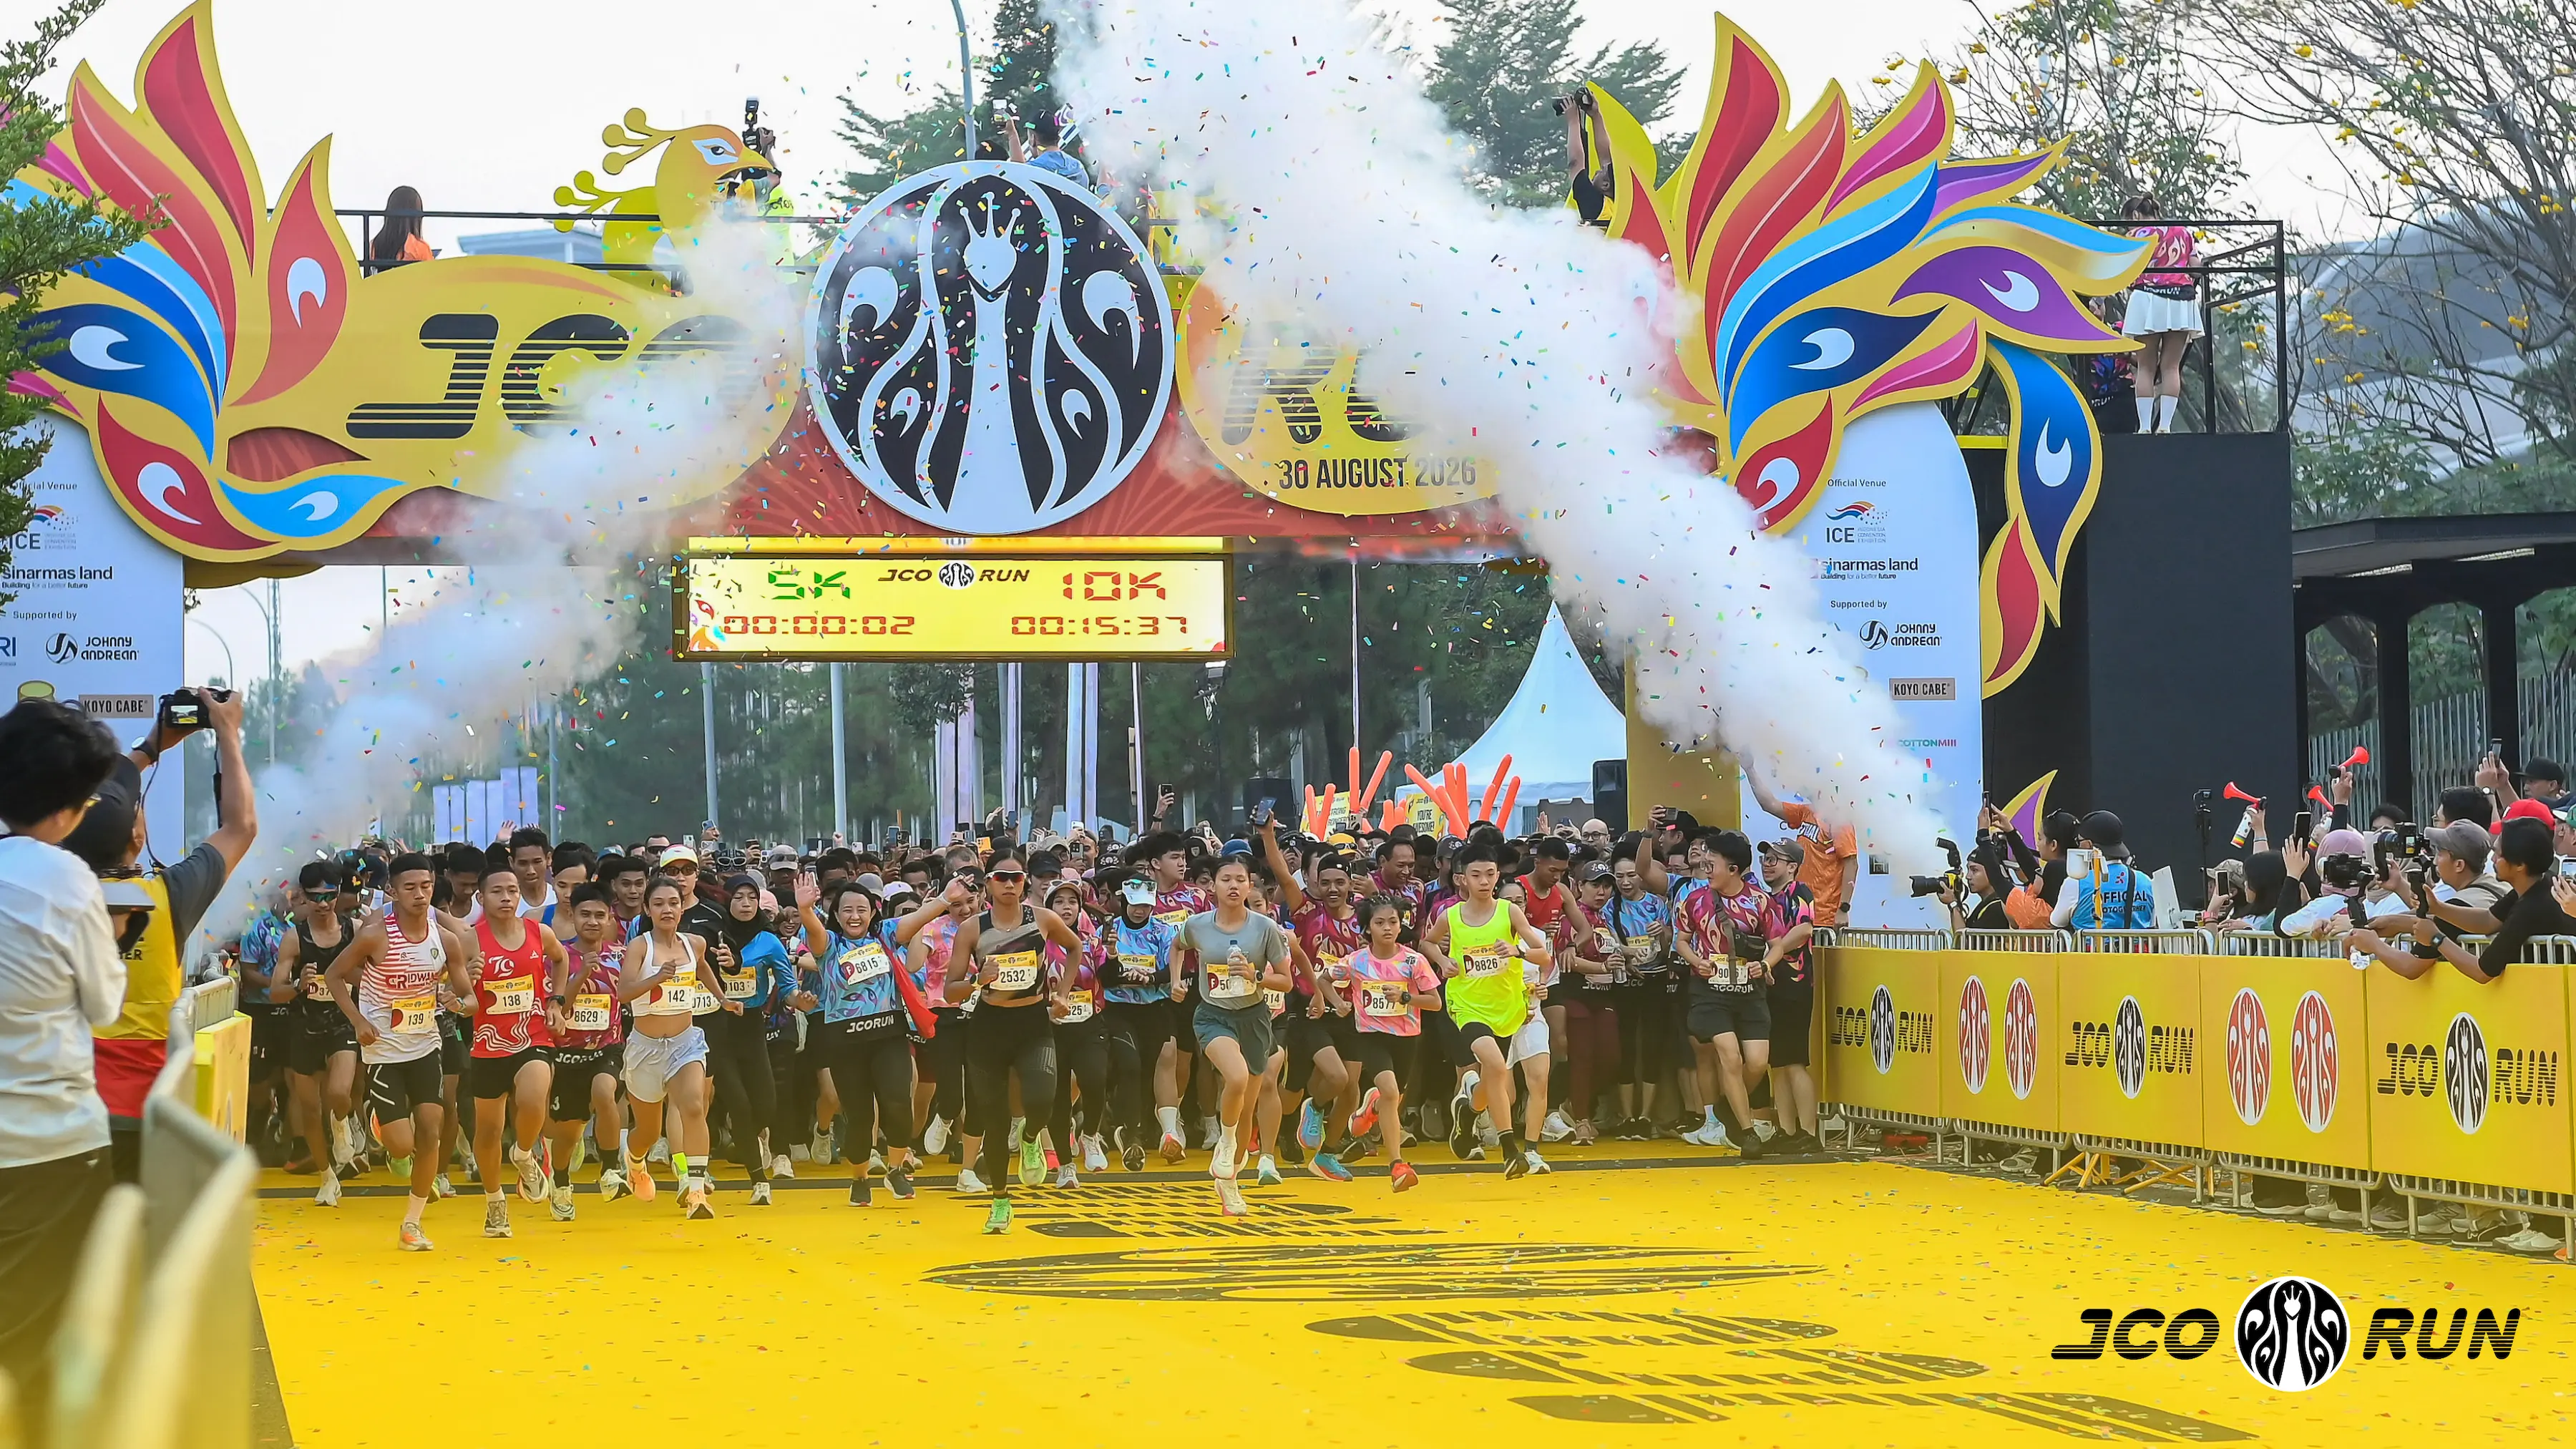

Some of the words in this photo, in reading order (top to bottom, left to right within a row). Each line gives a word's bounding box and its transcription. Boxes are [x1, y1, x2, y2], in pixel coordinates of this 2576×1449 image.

[345, 313, 762, 439] JCO
[1279, 459, 1309, 489] 30
[1316, 458, 1408, 489] AUGUST
[1414, 457, 1476, 487] 2026
[1826, 527, 1855, 542] ICE
[1889, 558, 1918, 570] land
[2, 566, 76, 580] sinarmas
[79, 566, 113, 580] land
[877, 569, 933, 582] JCO
[978, 569, 1030, 582] RUN
[768, 570, 851, 600] 5K
[1063, 572, 1166, 601] 10K
[1830, 600, 1875, 609] Supported
[1877, 600, 1888, 610] by
[13, 611, 63, 620] Supported
[66, 611, 77, 621] by
[723, 615, 915, 635] 00:00:02
[1011, 616, 1187, 635] 00:15:37
[1895, 624, 1936, 633] JOHNNY
[85, 636, 132, 646] JOHNNY
[1894, 683, 1918, 696] KOYO
[1922, 683, 1946, 696] CABE
[84, 700, 112, 713] KOYO
[116, 700, 144, 713] CABE
[2094, 890, 2147, 903] FFICAL
[846, 967, 852, 976] F
[1475, 958, 1498, 972] 8826
[1000, 970, 1025, 983] 2532
[1211, 978, 1216, 989] F
[502, 994, 521, 1008] 138
[667, 990, 685, 1003] 142
[408, 1013, 424, 1026] 139
[574, 1010, 598, 1023] 8629
[846, 1014, 894, 1033] JCORUN
[1830, 1006, 1867, 1048] JCO
[1898, 1011, 1933, 1054] RUN
[2064, 1021, 2111, 1068] JCO
[2149, 1025, 2194, 1075] RUN
[2376, 1043, 2439, 1098] JCO
[2494, 1048, 2558, 1107] RUN
